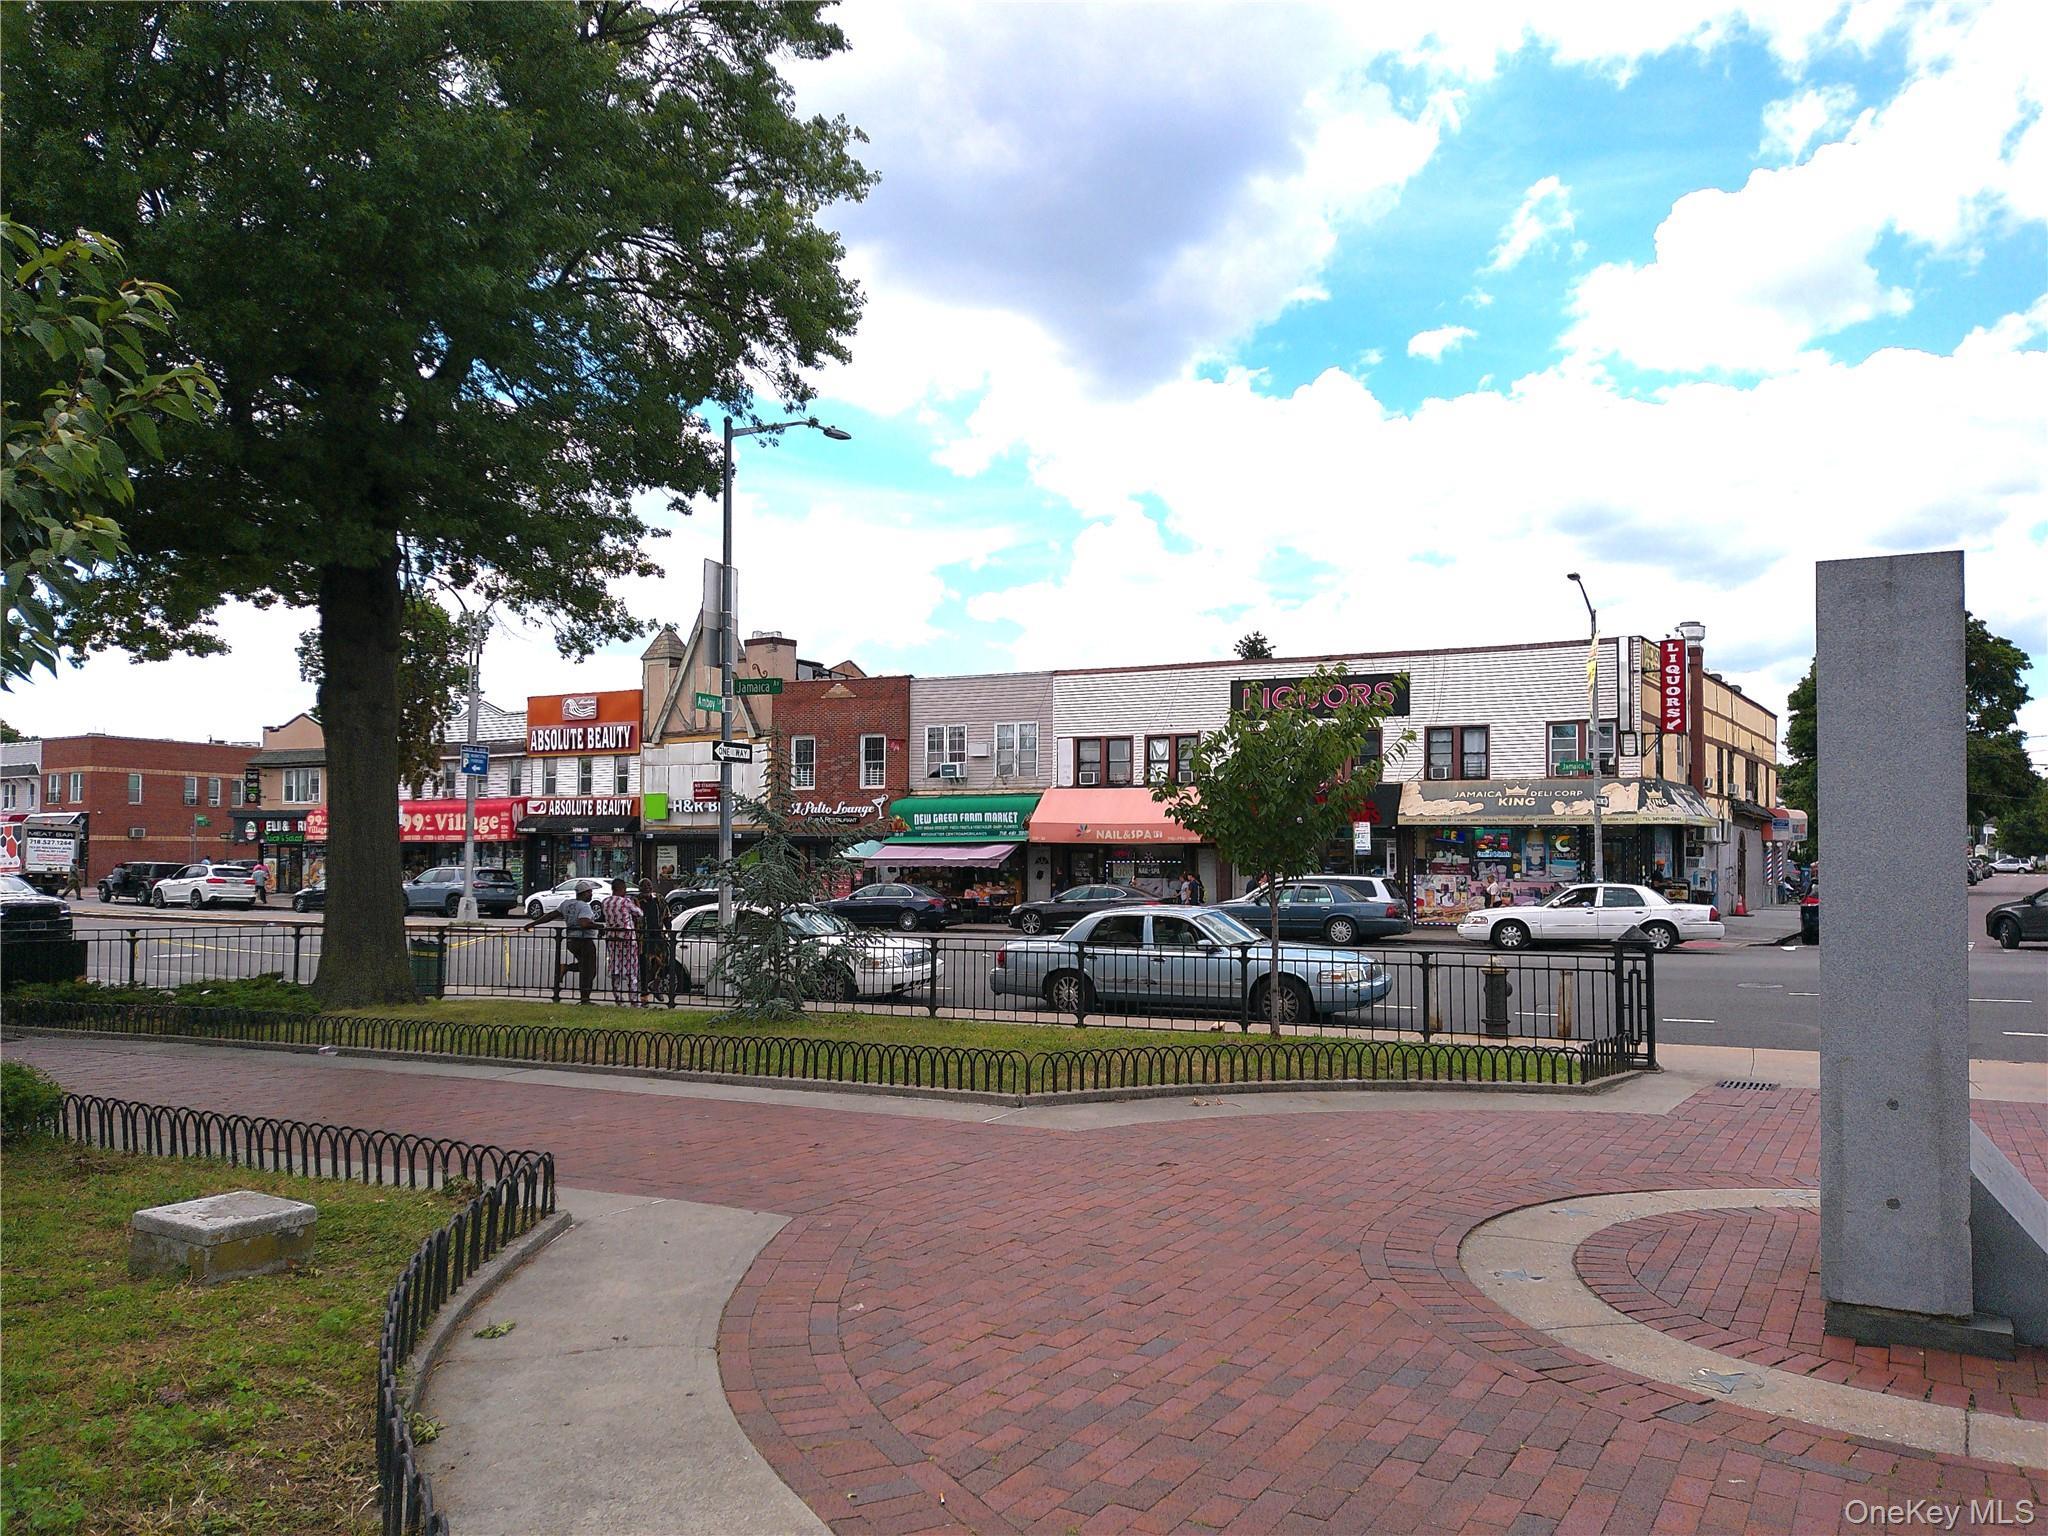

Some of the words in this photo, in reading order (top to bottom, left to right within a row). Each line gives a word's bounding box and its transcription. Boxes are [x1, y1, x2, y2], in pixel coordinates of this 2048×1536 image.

[1665, 643, 1681, 718] LIQUORS
[736, 681, 770, 693] Jamaica
[697, 696, 715, 710] Amboy
[530, 728, 583, 751] ABSOLUTE
[587, 726, 631, 749] BEAUTY
[718, 747, 730, 756] ONE
[735, 749, 748, 757] WAY
[548, 800, 593, 816] ABSOLUTE
[596, 799, 633, 815] BEAUTY
[673, 800, 703, 812] H&R
[1498, 797, 1536, 806] KING
[1646, 798, 1669, 807] KING
[832, 801, 875, 817] Lounge
[914, 814, 931, 825] NEW
[933, 813, 958, 823] GREEN
[960, 812, 983, 823] FARM
[984, 812, 1019, 824] MARKET
[282, 820, 290, 832] &
[1096, 829, 1152, 840] NAIL&SPA
